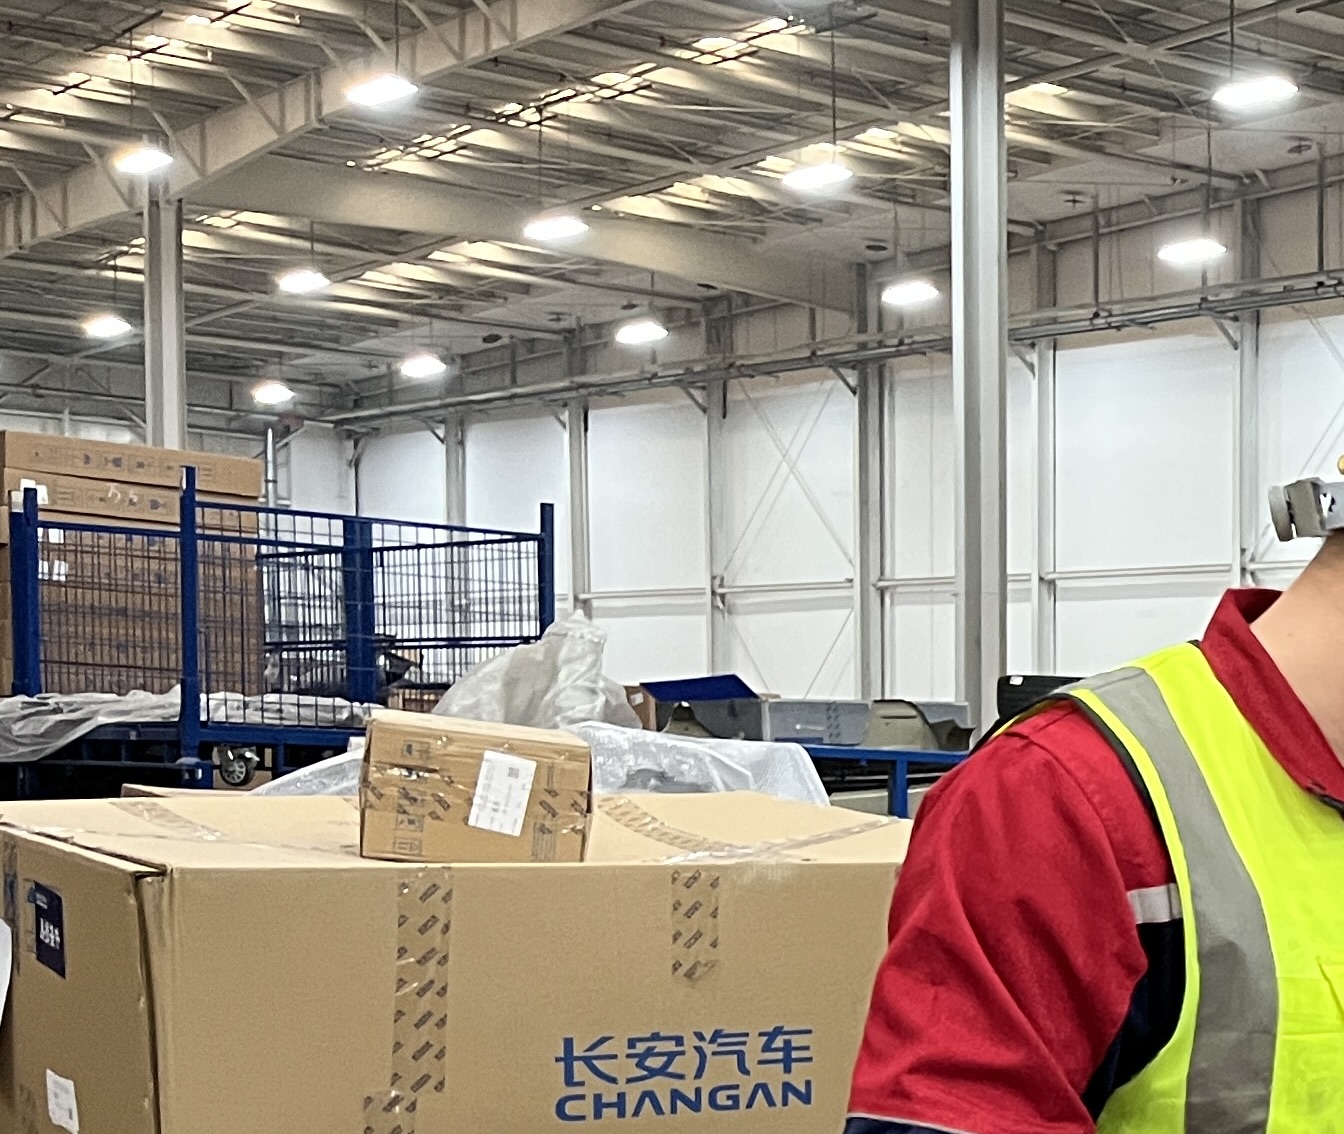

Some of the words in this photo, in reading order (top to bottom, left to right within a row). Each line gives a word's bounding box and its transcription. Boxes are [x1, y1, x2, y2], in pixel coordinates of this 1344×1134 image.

[554, 1024, 814, 1088] 长安汽车
[554, 1079, 813, 1122] CHANGAN
